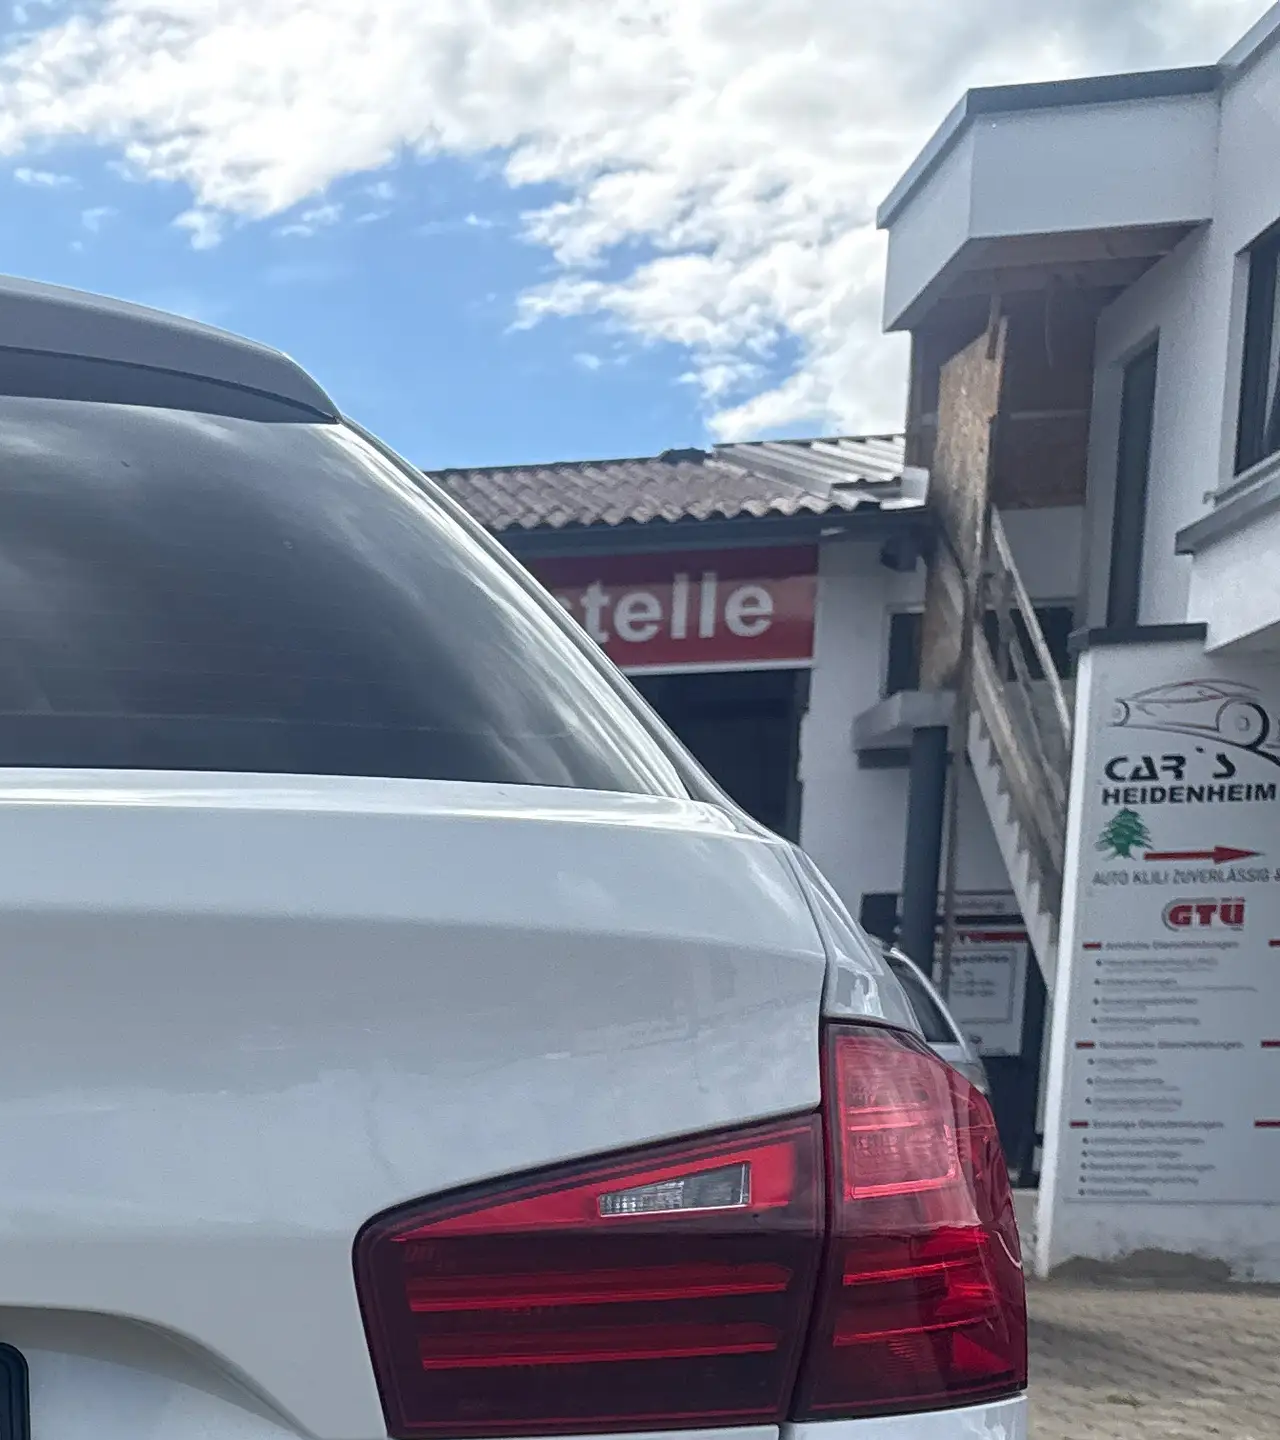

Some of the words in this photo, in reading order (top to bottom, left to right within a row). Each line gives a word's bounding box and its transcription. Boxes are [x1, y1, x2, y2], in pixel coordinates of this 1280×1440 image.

[557, 570, 774, 644] telle
[1101, 783, 1277, 805] HEIDENHEIM
[1092, 870, 1129, 886] AUTO
[1168, 897, 1245, 926] GTÜ
